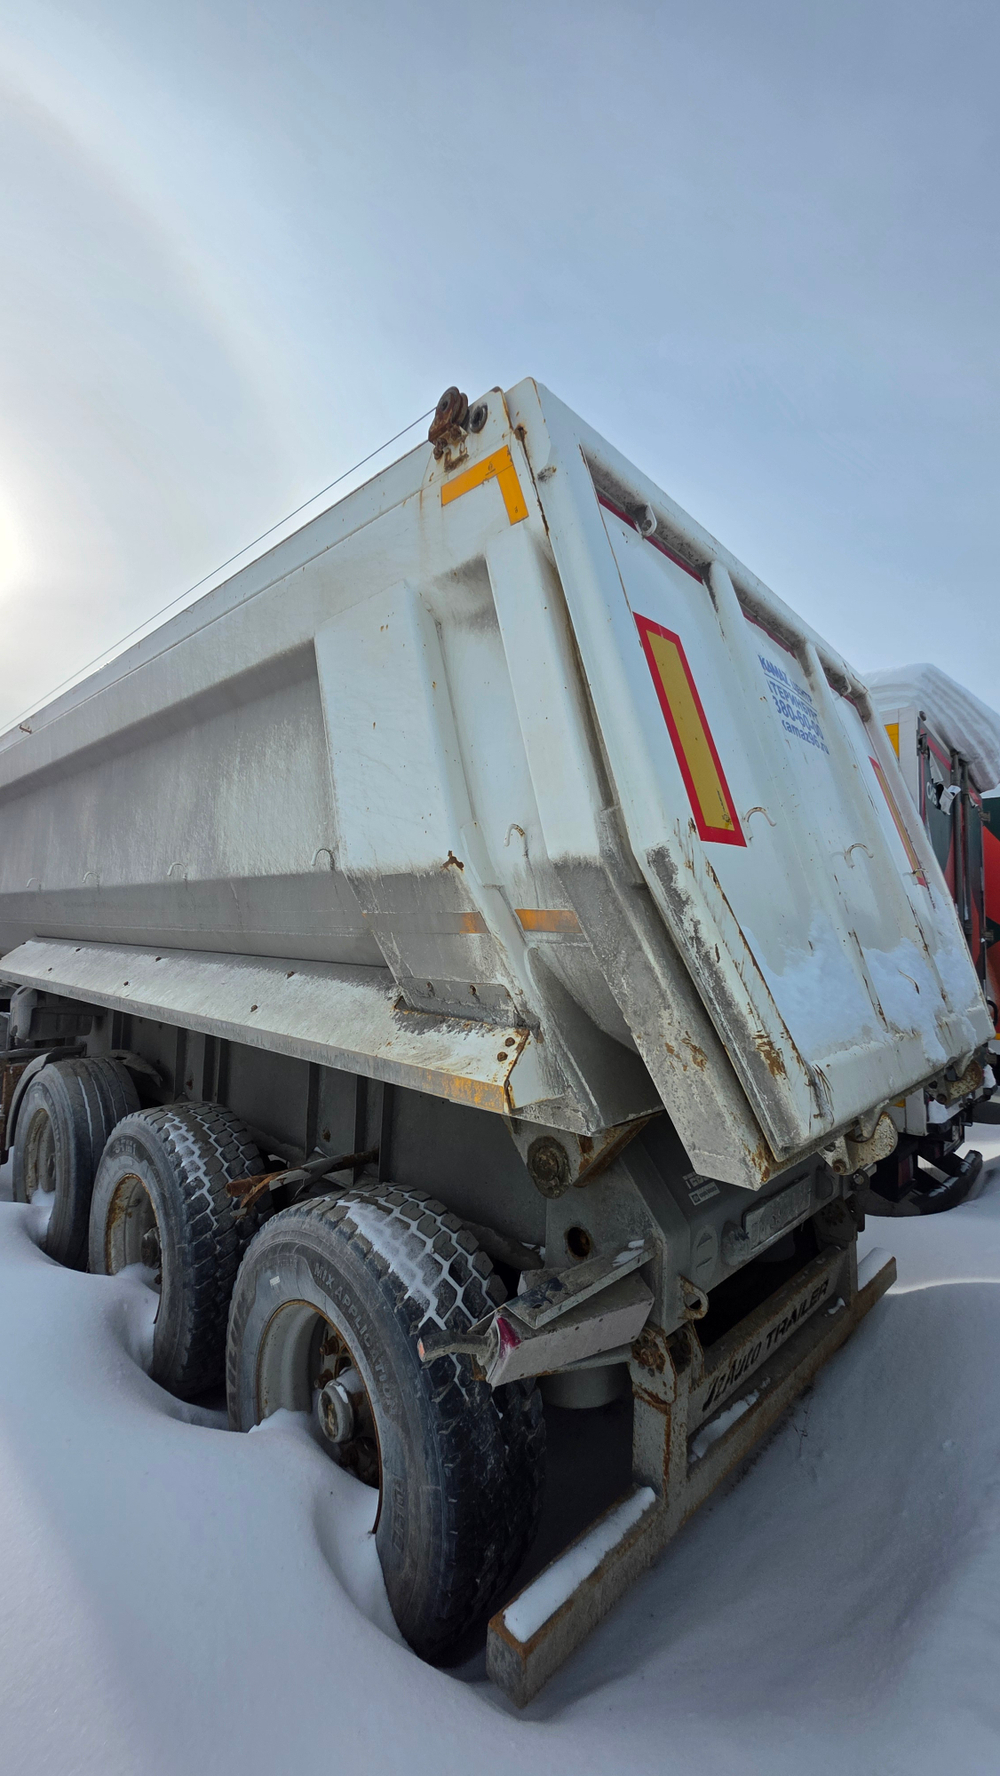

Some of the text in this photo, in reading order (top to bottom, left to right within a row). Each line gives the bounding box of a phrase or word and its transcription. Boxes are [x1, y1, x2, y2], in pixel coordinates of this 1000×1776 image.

[314, 1263, 398, 1416] MIX APPLICATION
[766, 1278, 829, 1350] TRAILER
